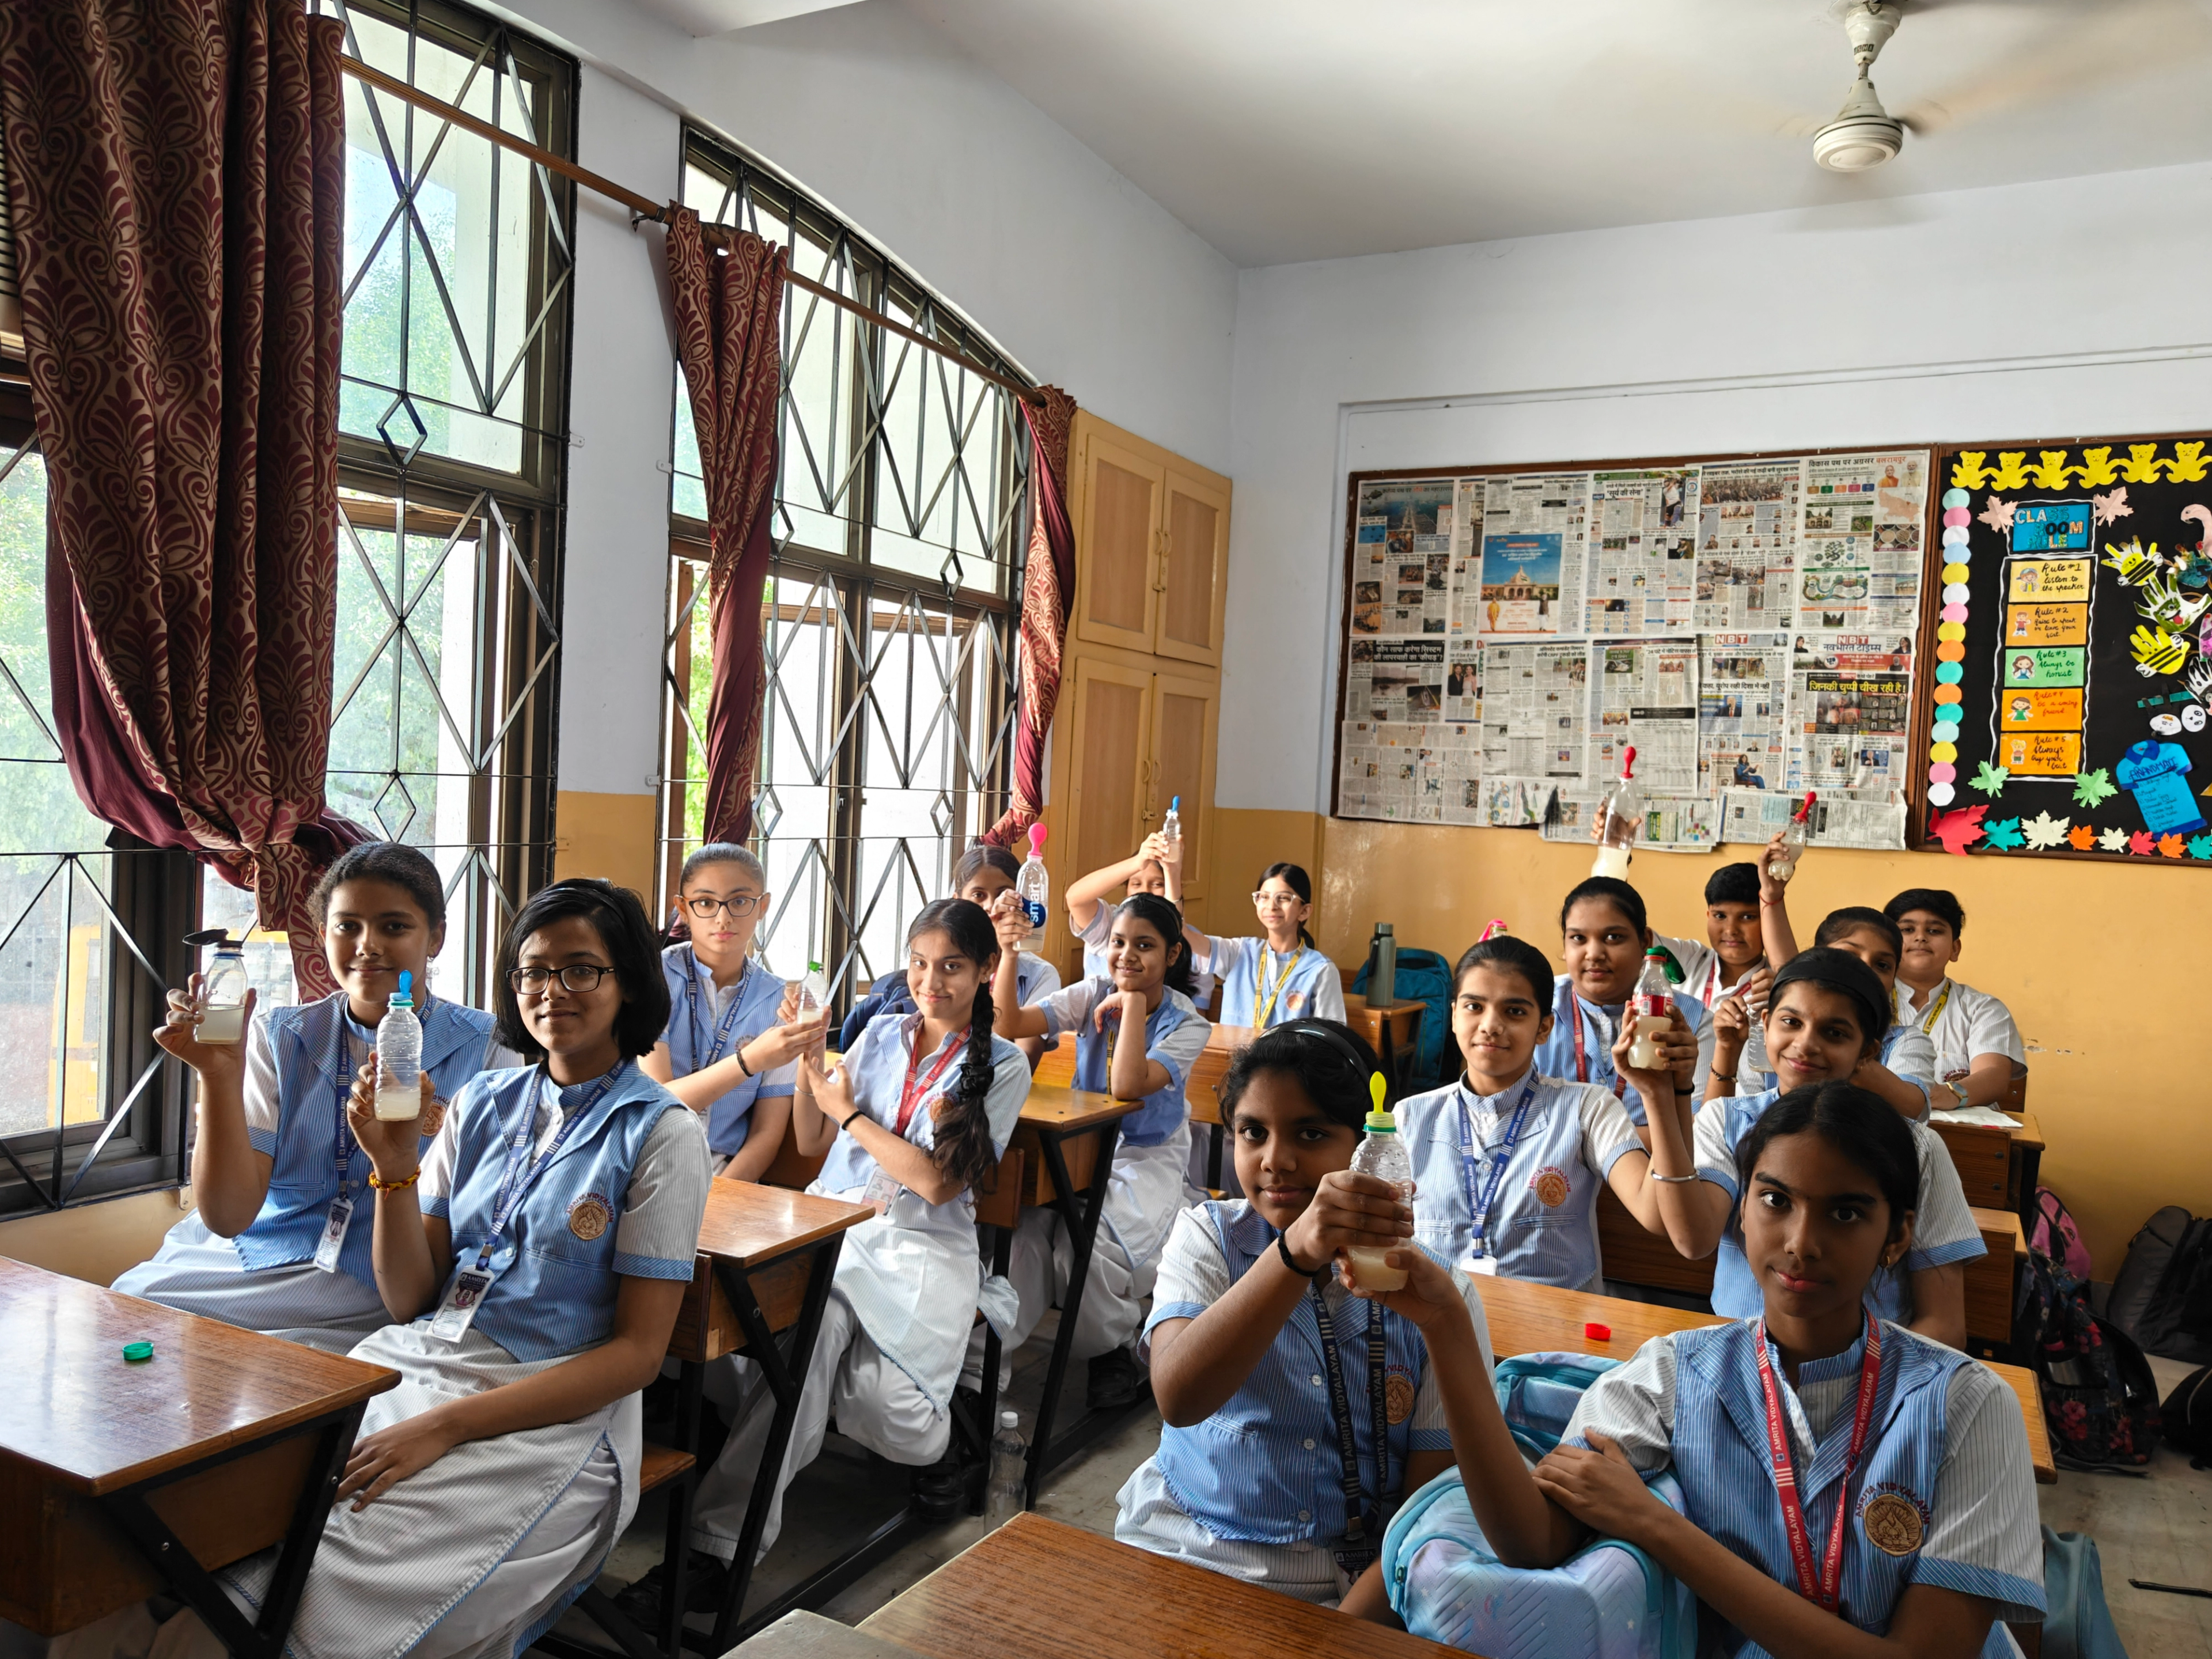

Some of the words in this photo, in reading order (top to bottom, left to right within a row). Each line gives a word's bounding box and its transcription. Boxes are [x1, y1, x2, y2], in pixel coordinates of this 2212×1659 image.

[1809, 459, 1830, 467] विकास
[2016, 507, 2070, 524] CLASS
[2035, 521, 2084, 536] ROOM
[2028, 534, 2068, 549] RULE
[2042, 562, 2066, 576] Rule
[2035, 607, 2054, 618] Rule
[1715, 634, 1748, 644] NBT
[1823, 643, 1854, 652] नवभारत
[1856, 643, 1881, 653] टाइम्स
[1838, 635, 1868, 645] NBT
[2036, 650, 2054, 661] Rule
[2038, 661, 2062, 671] Always
[1809, 680, 1838, 691] जिनकी
[1839, 680, 1858, 695] चुप्पी
[1859, 681, 1879, 692] चीख
[1880, 681, 1894, 693] रही
[2046, 669, 2073, 678] honest
[2034, 691, 2052, 700] Rule
[2032, 745, 2064, 758] Always
[2035, 735, 2052, 745] Rule
[1029, 882, 1040, 922] smart
[725, 997, 741, 1029] VIDYALAYAM
[523, 1101, 533, 1126] AMRITA
[528, 1073, 541, 1102] VIDYALAYAM
[563, 1115, 579, 1135] AMRITA
[576, 1088, 603, 1116] VIDYALAYAM
[1510, 1121, 1520, 1138] AMRITA
[496, 1189, 507, 1214] AMRITA
[503, 1157, 516, 1191] VIDYALAYAM
[505, 1191, 520, 1214] AMRITA
[516, 1161, 543, 1194] VIDYALAYAM
[1467, 1164, 1477, 1194] VIDYALAYAM
[1484, 1191, 1493, 1208] AMRITA
[1490, 1162, 1503, 1191] VIDYALAYAM
[586, 1192, 615, 1222] VIDYALAYAM
[467, 1275, 488, 1284] AMRITA
[1328, 1344, 1347, 1415] VIDYALAYAM
[1373, 1368, 1385, 1440] VIDYALAYAM
[1762, 1372, 1777, 1419] VIDYALAYAM
[1853, 1422, 1864, 1452] AMRITA
[1860, 1372, 1874, 1421] VIDYALAYAM
[1338, 1415, 1354, 1457] AMRITA
[1771, 1419, 1782, 1450] AMRITA
[1379, 1440, 1387, 1479] AMRITA
[1855, 1484, 1877, 1517] AMRITA
[1877, 1482, 1930, 1525] VIDYALAYAM
[1785, 1505, 1805, 1563] VIDYALAYAM
[1828, 1505, 1843, 1559] VIDYALAYAM
[1797, 1564, 1814, 1597] AMRITA
[1824, 1560, 1836, 1593] AMRITA
